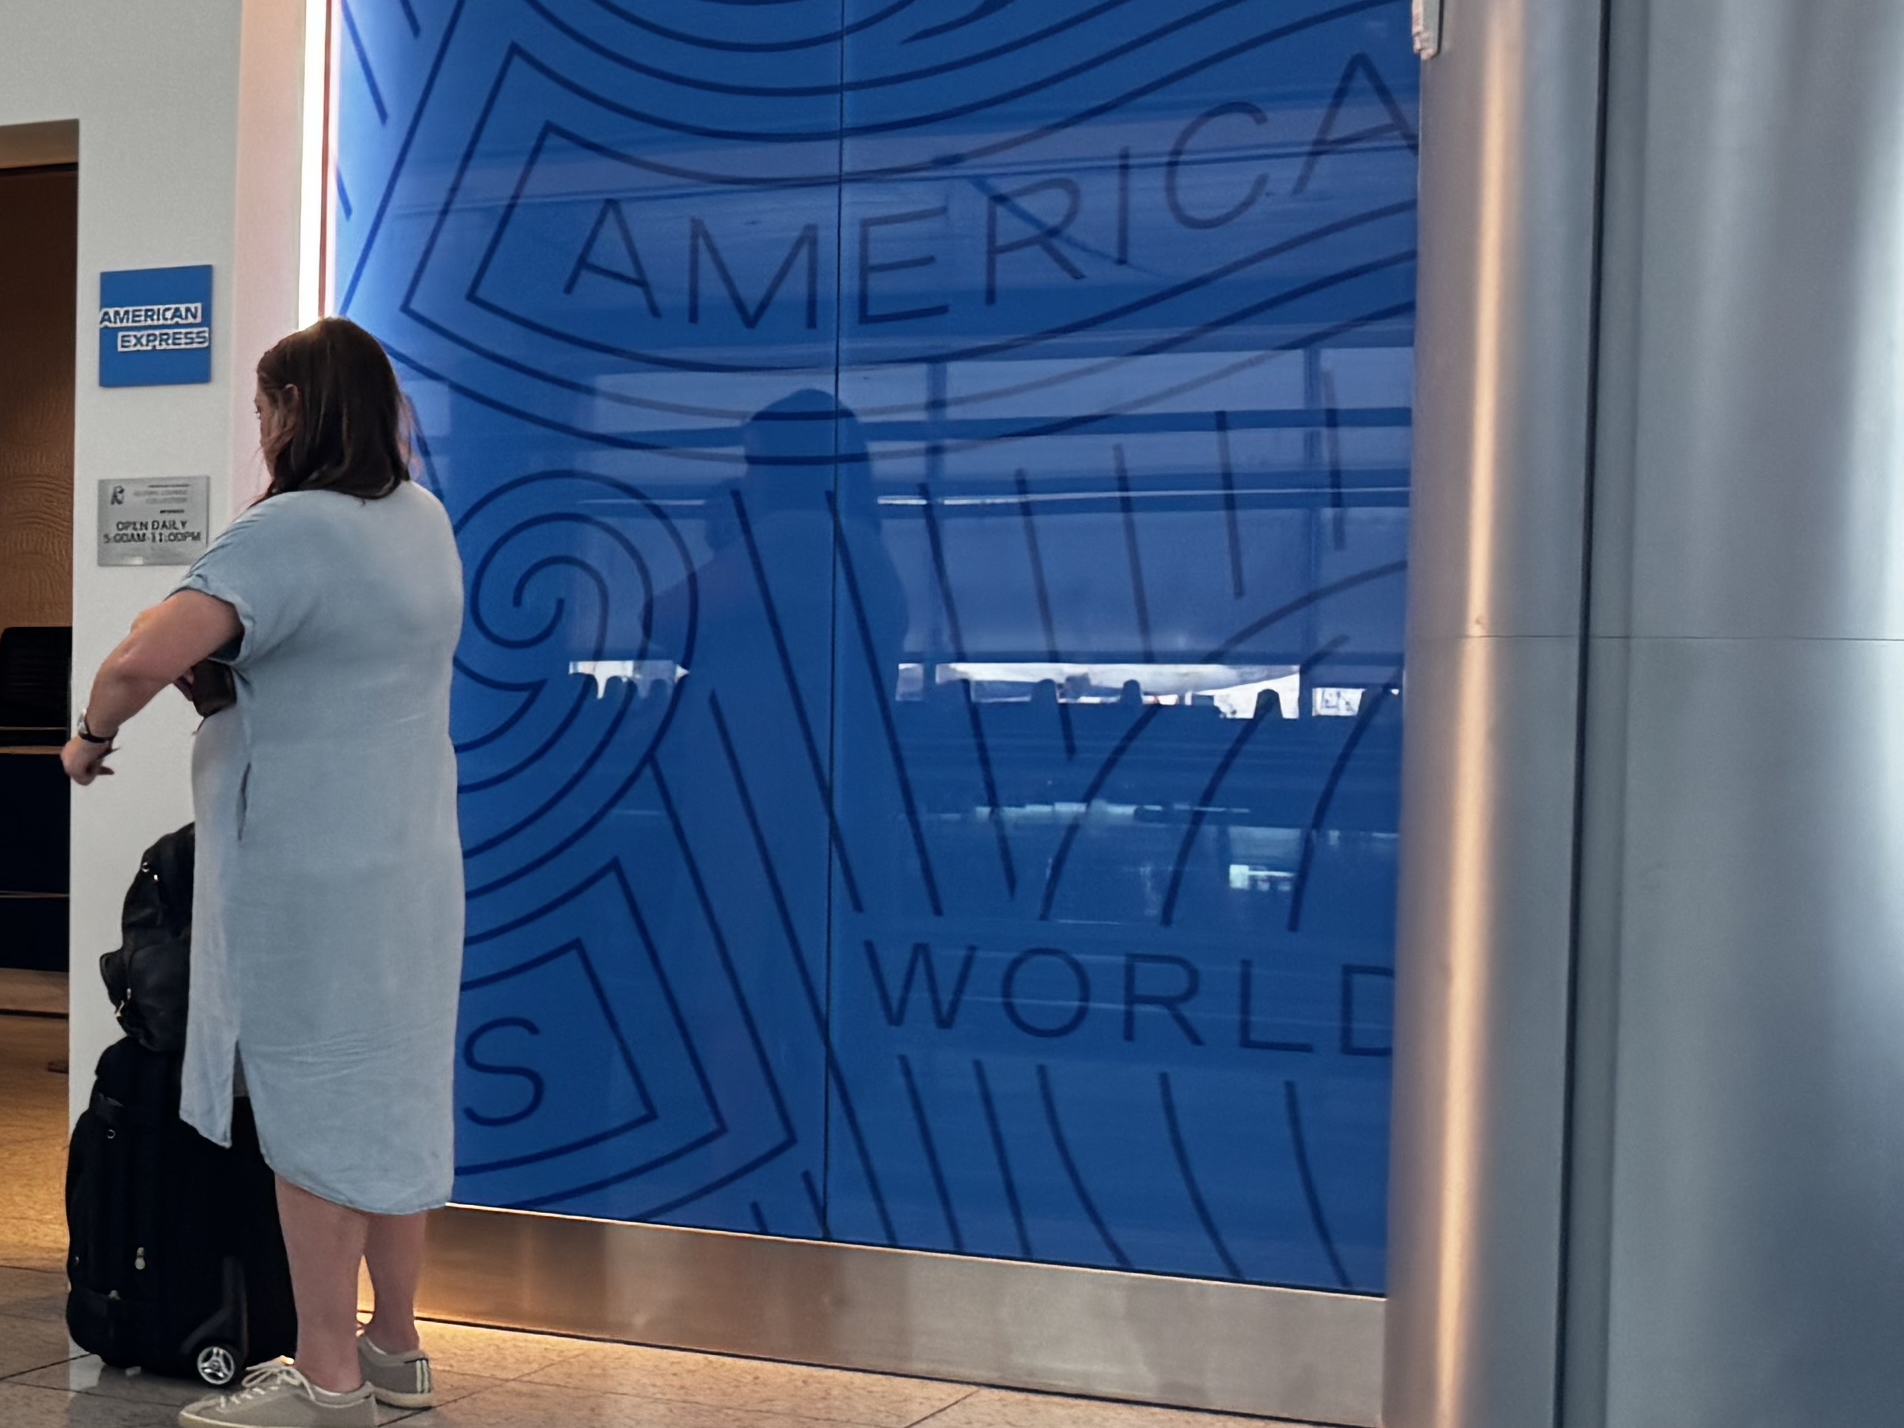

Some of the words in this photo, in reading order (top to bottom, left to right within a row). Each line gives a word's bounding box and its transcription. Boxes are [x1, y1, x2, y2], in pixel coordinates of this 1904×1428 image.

[100, 305, 199, 325] AMERICAN
[120, 330, 208, 349] EXPRESS
[863, 939, 1394, 1058] WORLD
